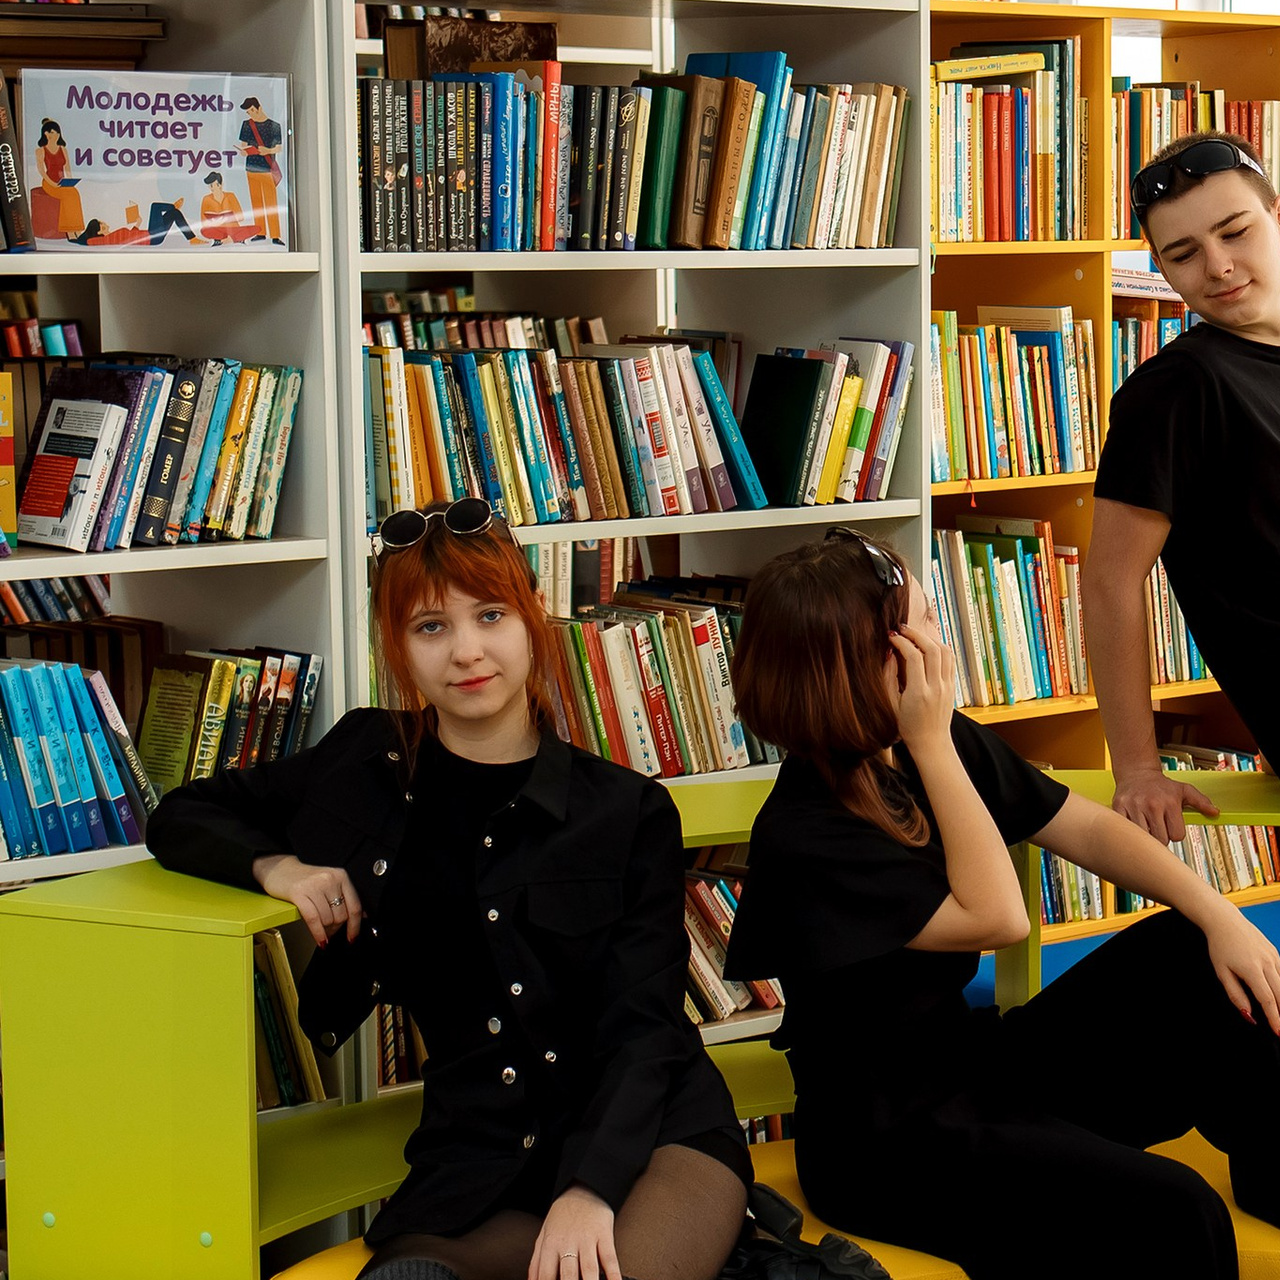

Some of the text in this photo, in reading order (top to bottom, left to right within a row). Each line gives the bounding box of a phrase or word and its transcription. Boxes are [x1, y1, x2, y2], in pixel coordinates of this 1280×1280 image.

[66, 85, 234, 116] Молодежь
[447, 92, 456, 126] УЖАСОВ
[549, 82, 560, 124] МРНЫ
[99, 121, 203, 140] читает
[448, 130, 456, 159] ШКОЛА
[75, 148, 238, 174] и советует
[721, 88, 751, 231] ШКОЛЬНЫЕ ГОДЫ
[482, 160, 492, 218] СПРАВЕДЛИВОСТЬ
[616, 154, 628, 225] Ловушка для героя
[96, 465, 108, 490] люди
[160, 453, 173, 485] ГОМЕР
[90, 501, 97, 513] не
[81, 514, 93, 540] люди
[707, 616, 730, 688] Виктор ЛУНИН
[272, 717, 284, 746] ВОДЫ
[656, 714, 672, 761] ПИТЕР ПЭН
[124, 745, 148, 790] КОРАЛИНА
